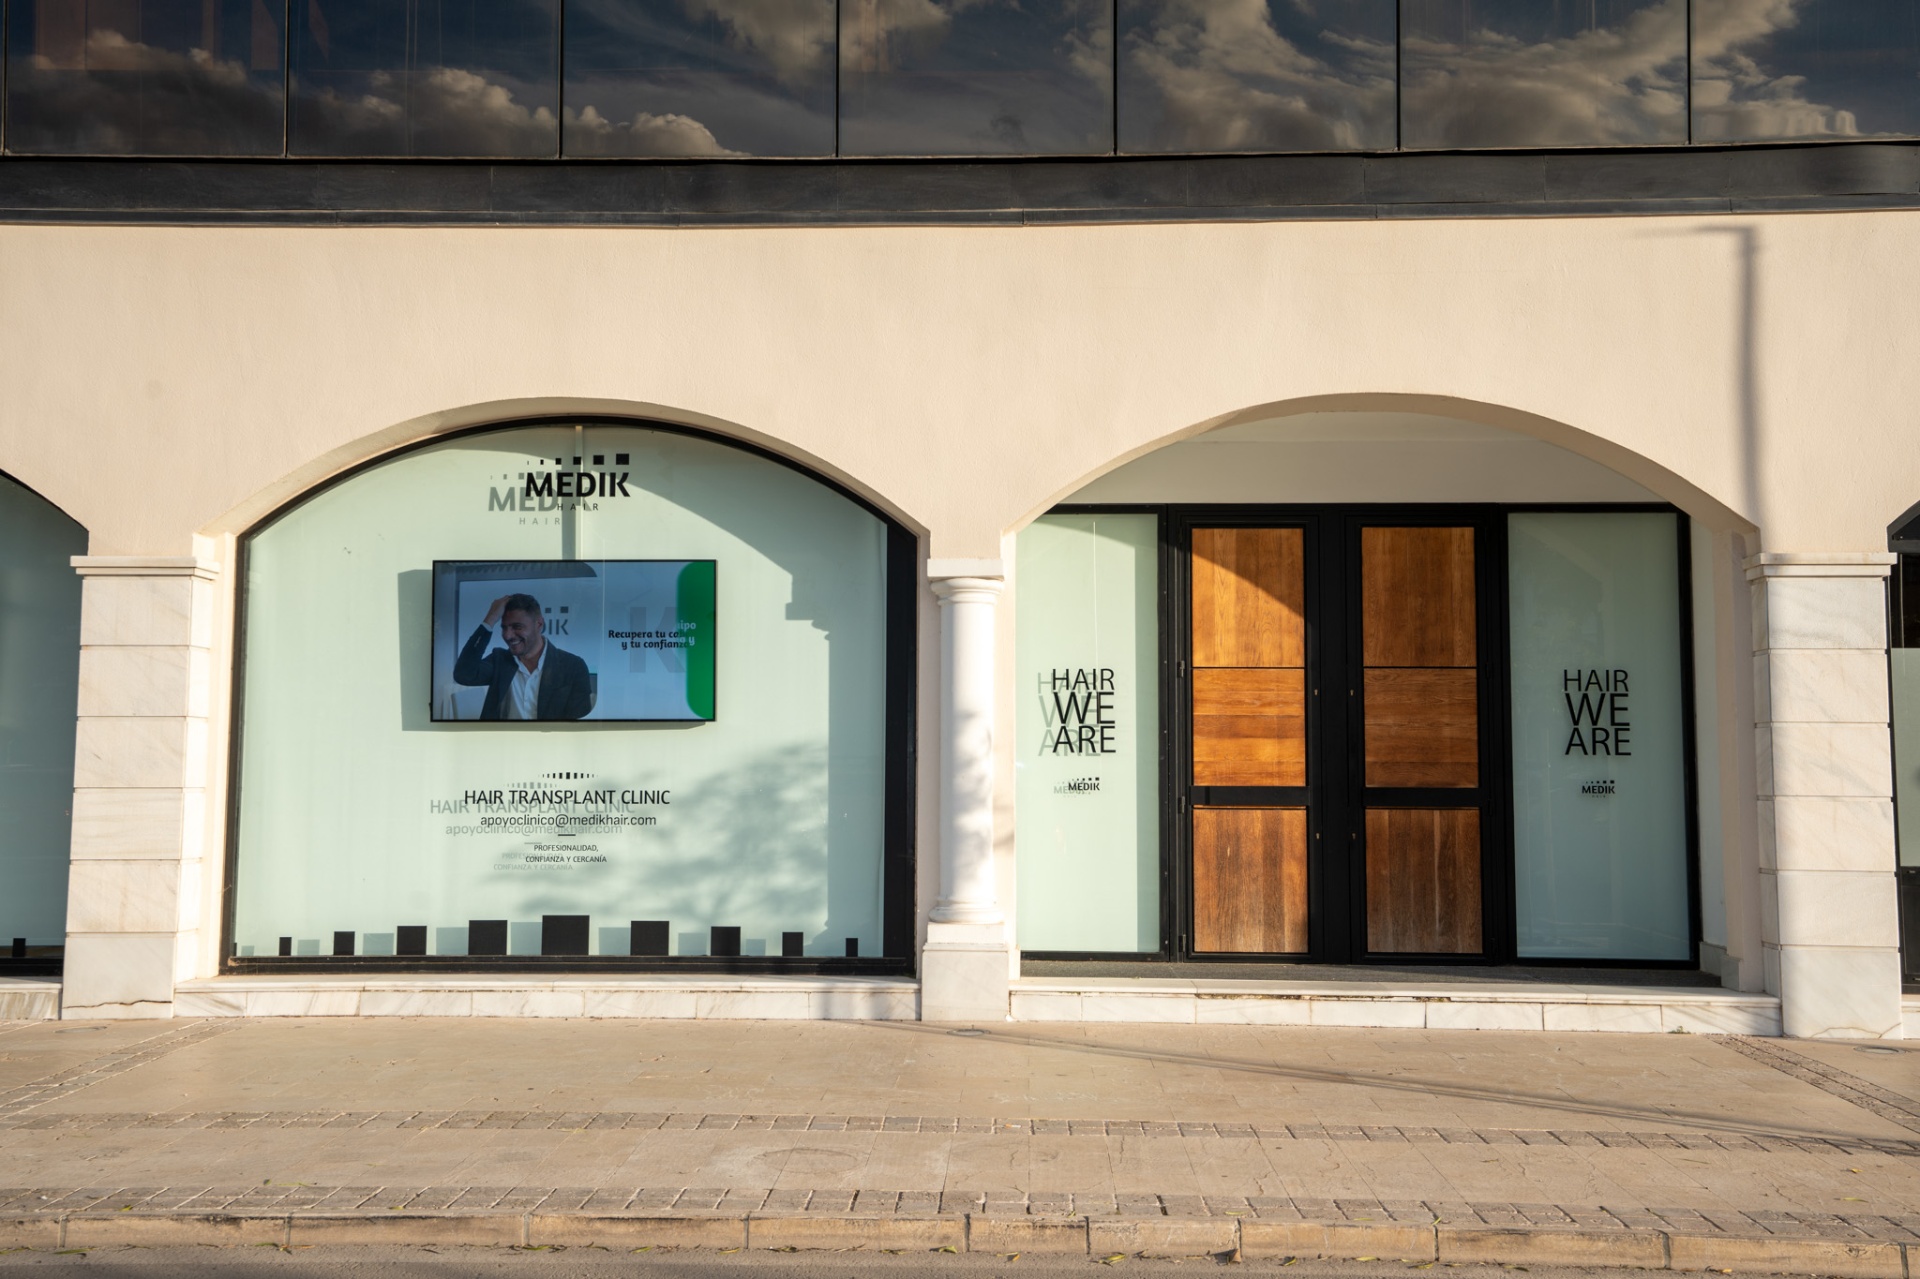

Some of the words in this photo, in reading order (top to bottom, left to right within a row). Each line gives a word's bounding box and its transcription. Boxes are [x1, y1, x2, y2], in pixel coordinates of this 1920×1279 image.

[525, 472, 631, 498] MEDIK
[556, 503, 599, 511] HAIR
[608, 629, 653, 641] Recupera
[655, 630, 666, 639] tu
[621, 641, 628, 650] y
[630, 640, 641, 649] tu
[1052, 668, 1115, 691] HAIR
[1563, 669, 1629, 692] HAIR
[1053, 691, 1116, 724] WE
[1565, 692, 1630, 726] WE
[1052, 725, 1116, 753] ARE
[1564, 727, 1632, 756] ARE
[1068, 782, 1100, 791] MEDIK
[1581, 785, 1616, 794] MEDIK
[464, 790, 504, 805] HAIR
[509, 790, 616, 805] TRANSPLANT
[620, 790, 671, 805] CLINIC
[480, 813, 657, 828] apoyoclinico@medikhair.com
[533, 844, 599, 853] PROFESIONALIDAD,
[525, 855, 566, 863] CONFIANZA
[566, 855, 572, 863] Y
[573, 853, 608, 863] CERCANÍA
